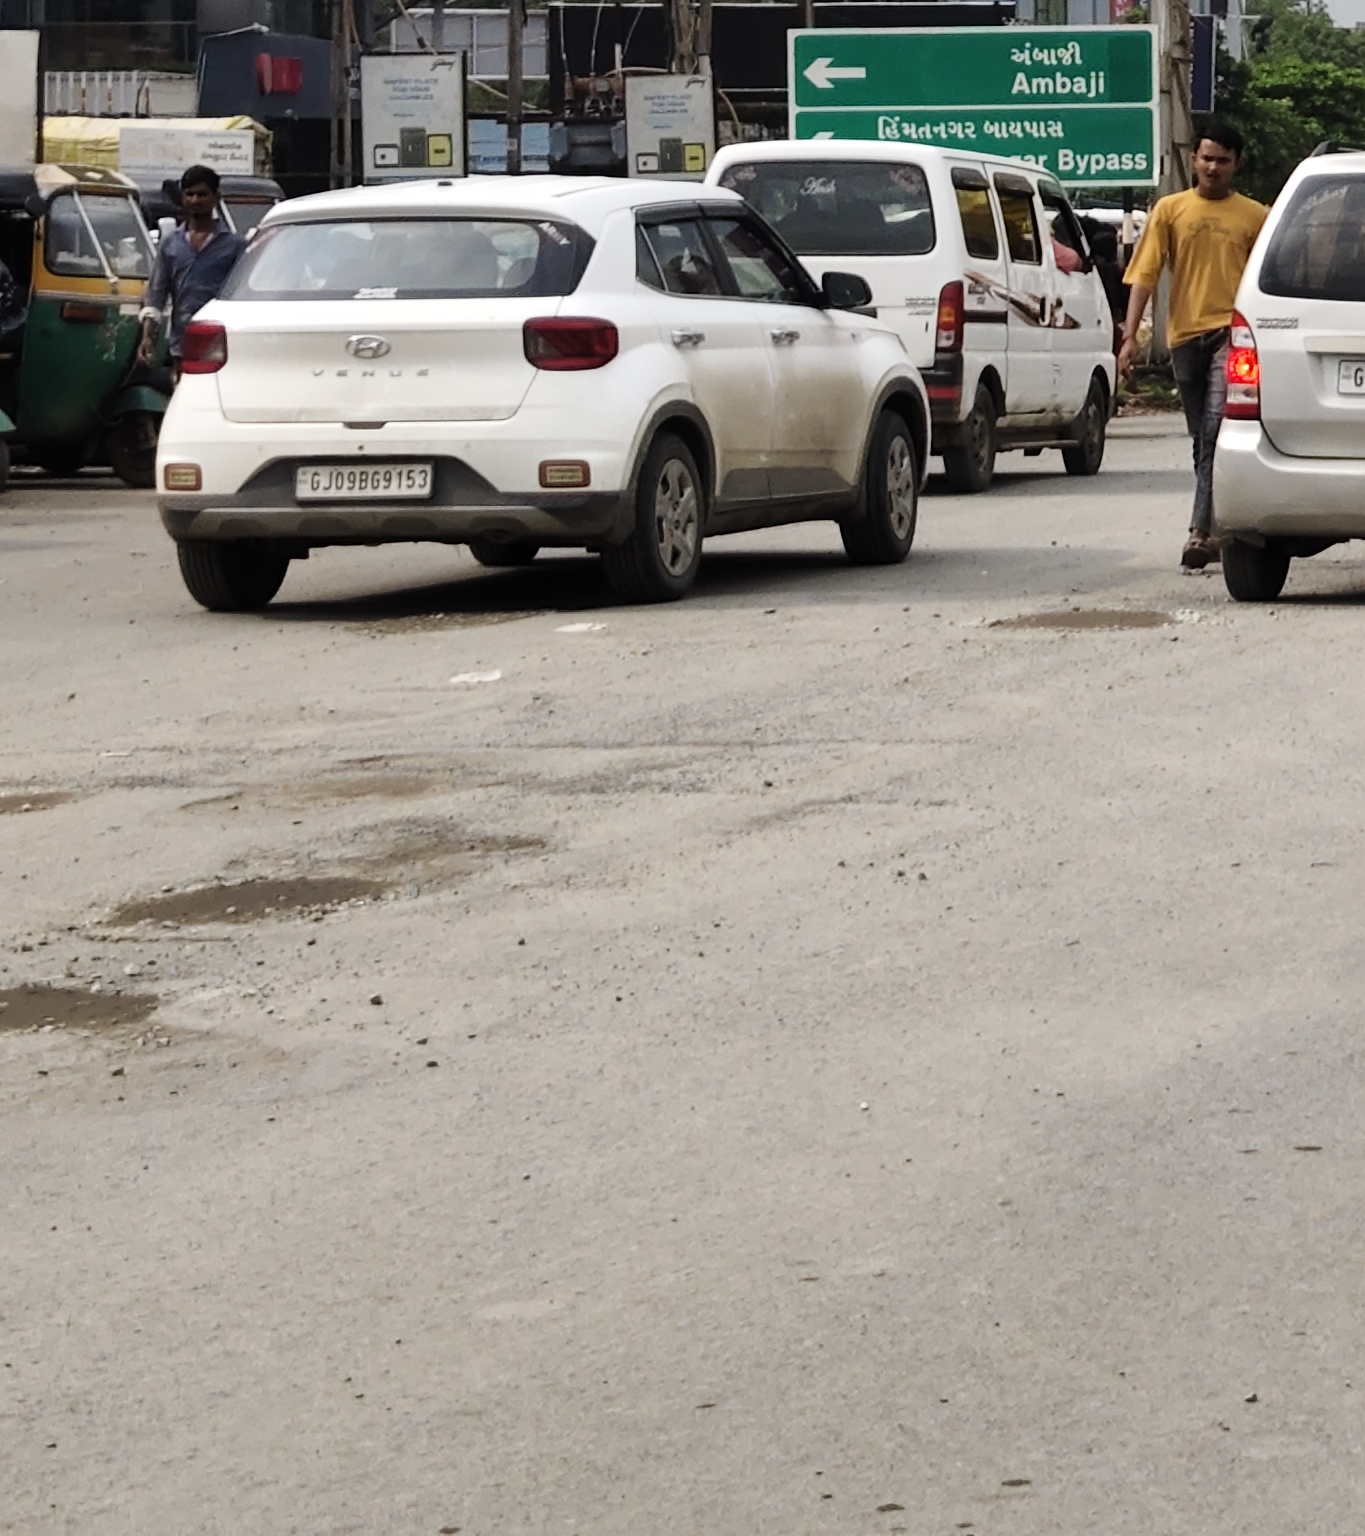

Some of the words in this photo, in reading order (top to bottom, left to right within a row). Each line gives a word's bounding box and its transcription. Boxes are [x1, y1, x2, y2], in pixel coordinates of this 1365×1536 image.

[1010, 41, 1083, 66] અંબાજી
[1011, 72, 1105, 99] Ambaji
[878, 116, 977, 140] હિંમતનગર
[983, 120, 1064, 139] બાયપાસ
[1058, 149, 1148, 175] Bypass
[311, 368, 430, 378] VENUE
[310, 469, 428, 491] GJ09BG9153
